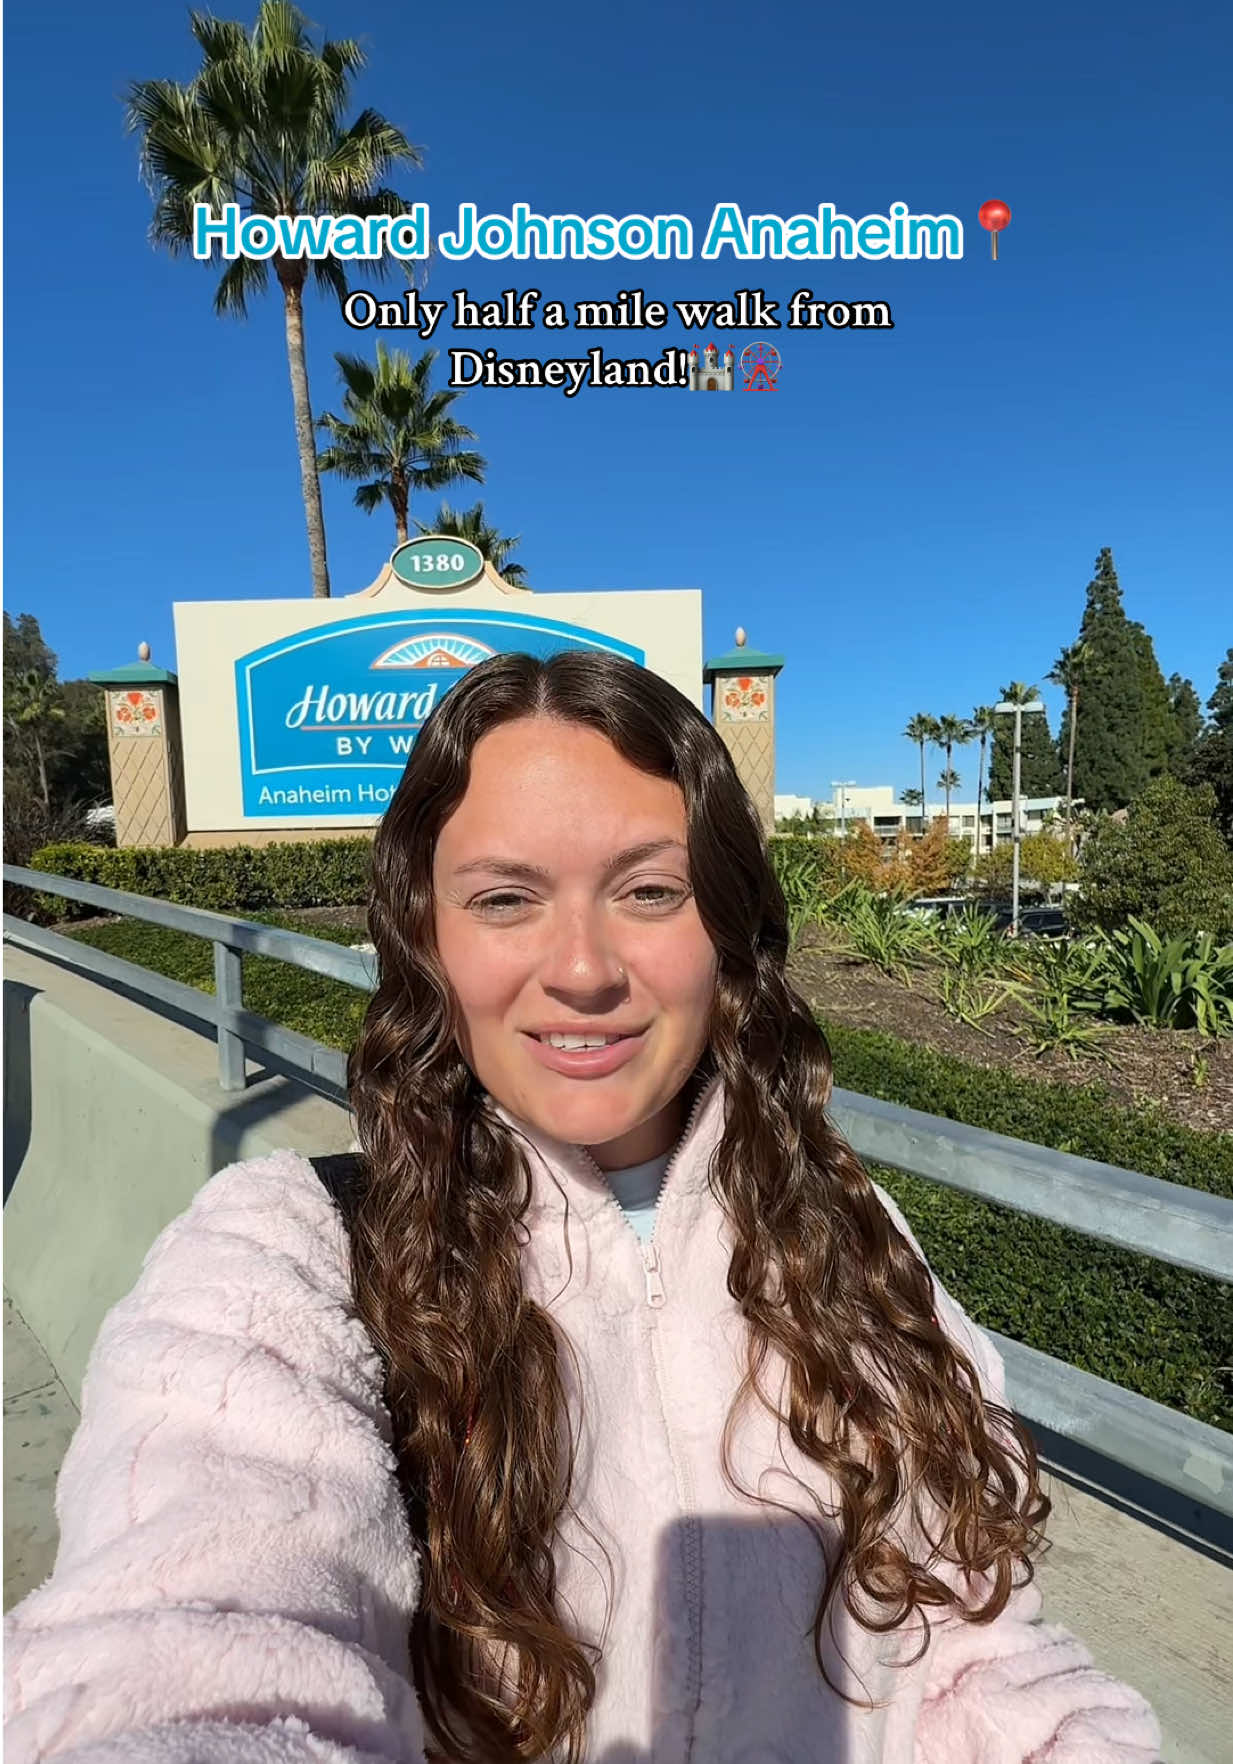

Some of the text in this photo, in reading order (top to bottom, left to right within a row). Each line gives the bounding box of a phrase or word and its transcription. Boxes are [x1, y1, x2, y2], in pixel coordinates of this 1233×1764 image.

[409, 553, 465, 573] 1380
[285, 683, 438, 729] Howard
[336, 736, 373, 756] BY
[258, 785, 352, 805] Anaheim
